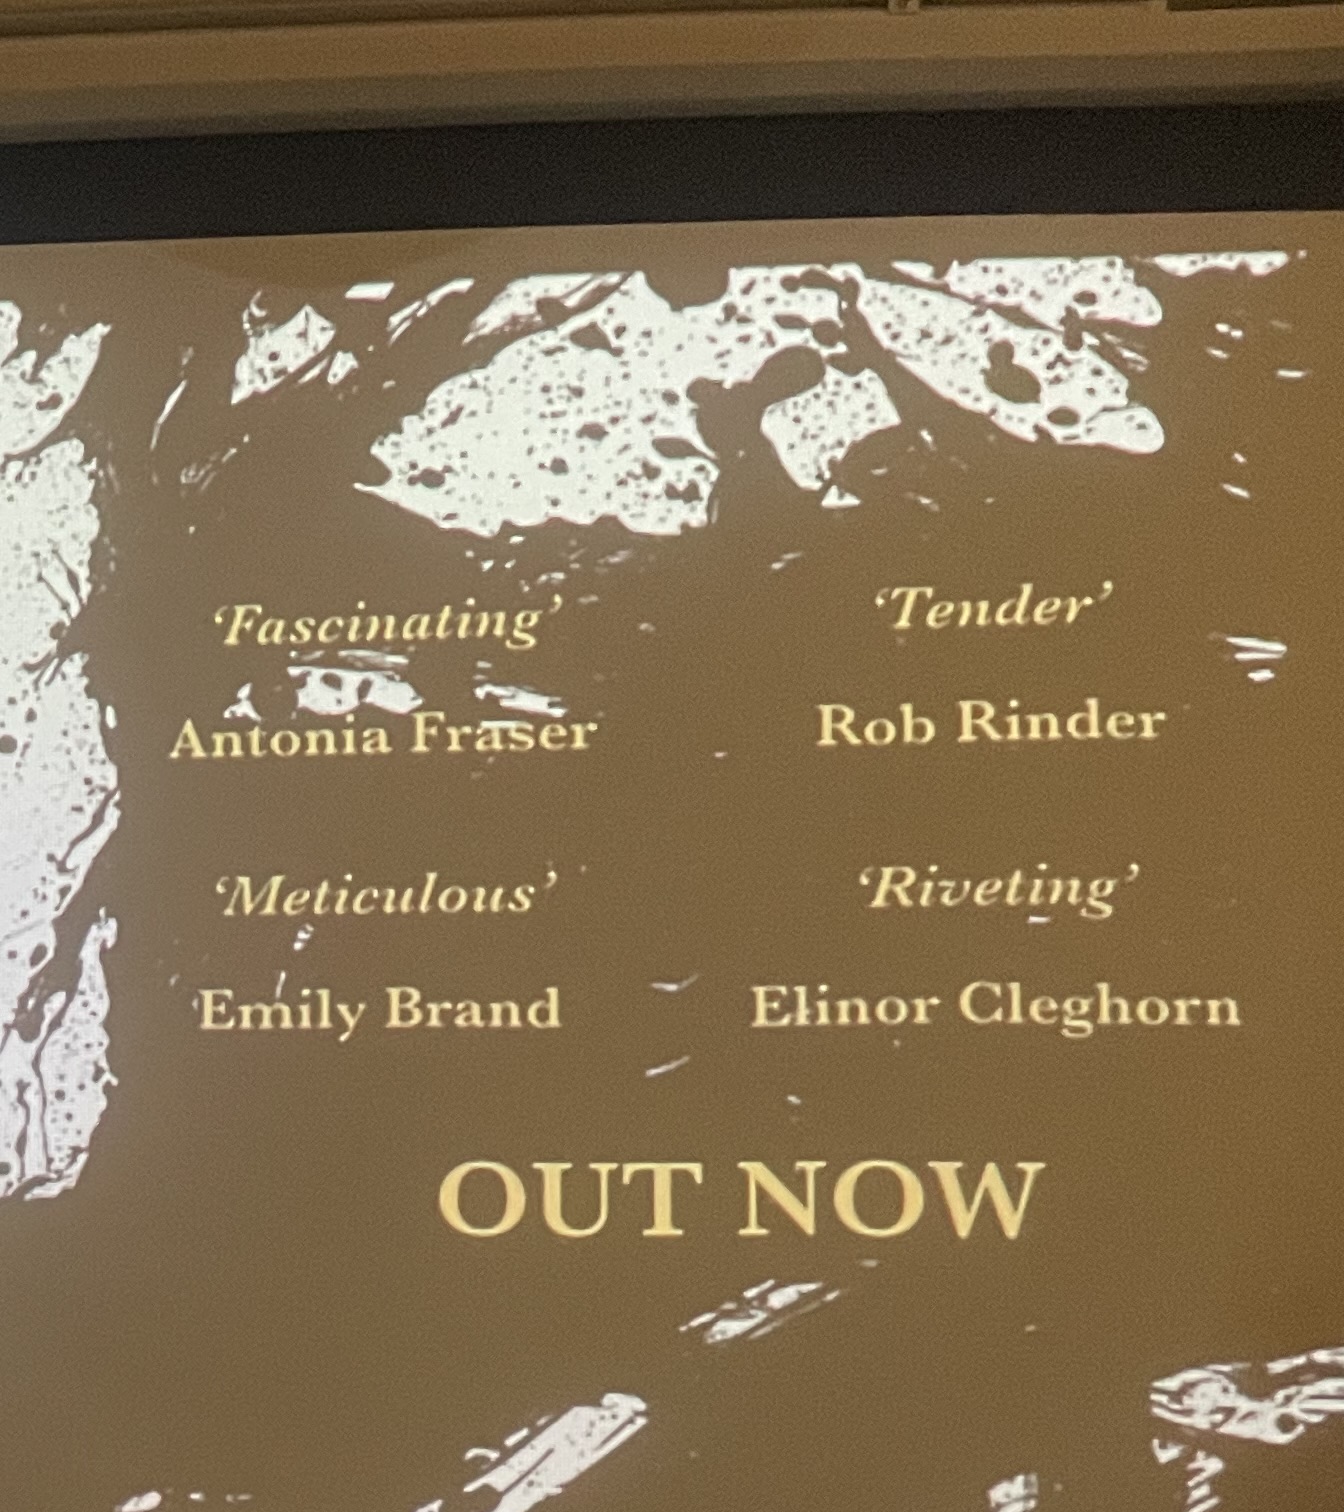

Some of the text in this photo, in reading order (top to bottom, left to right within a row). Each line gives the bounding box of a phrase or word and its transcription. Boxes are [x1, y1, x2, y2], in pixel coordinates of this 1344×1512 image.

[169, 710, 599, 758] Antonia Fraser
[815, 697, 1167, 747] Rob Rinder
[198, 985, 563, 1041] Emily Brand
[751, 981, 1241, 1039] Elinor Cleghorn
[437, 1158, 1047, 1240] OUT NOW
